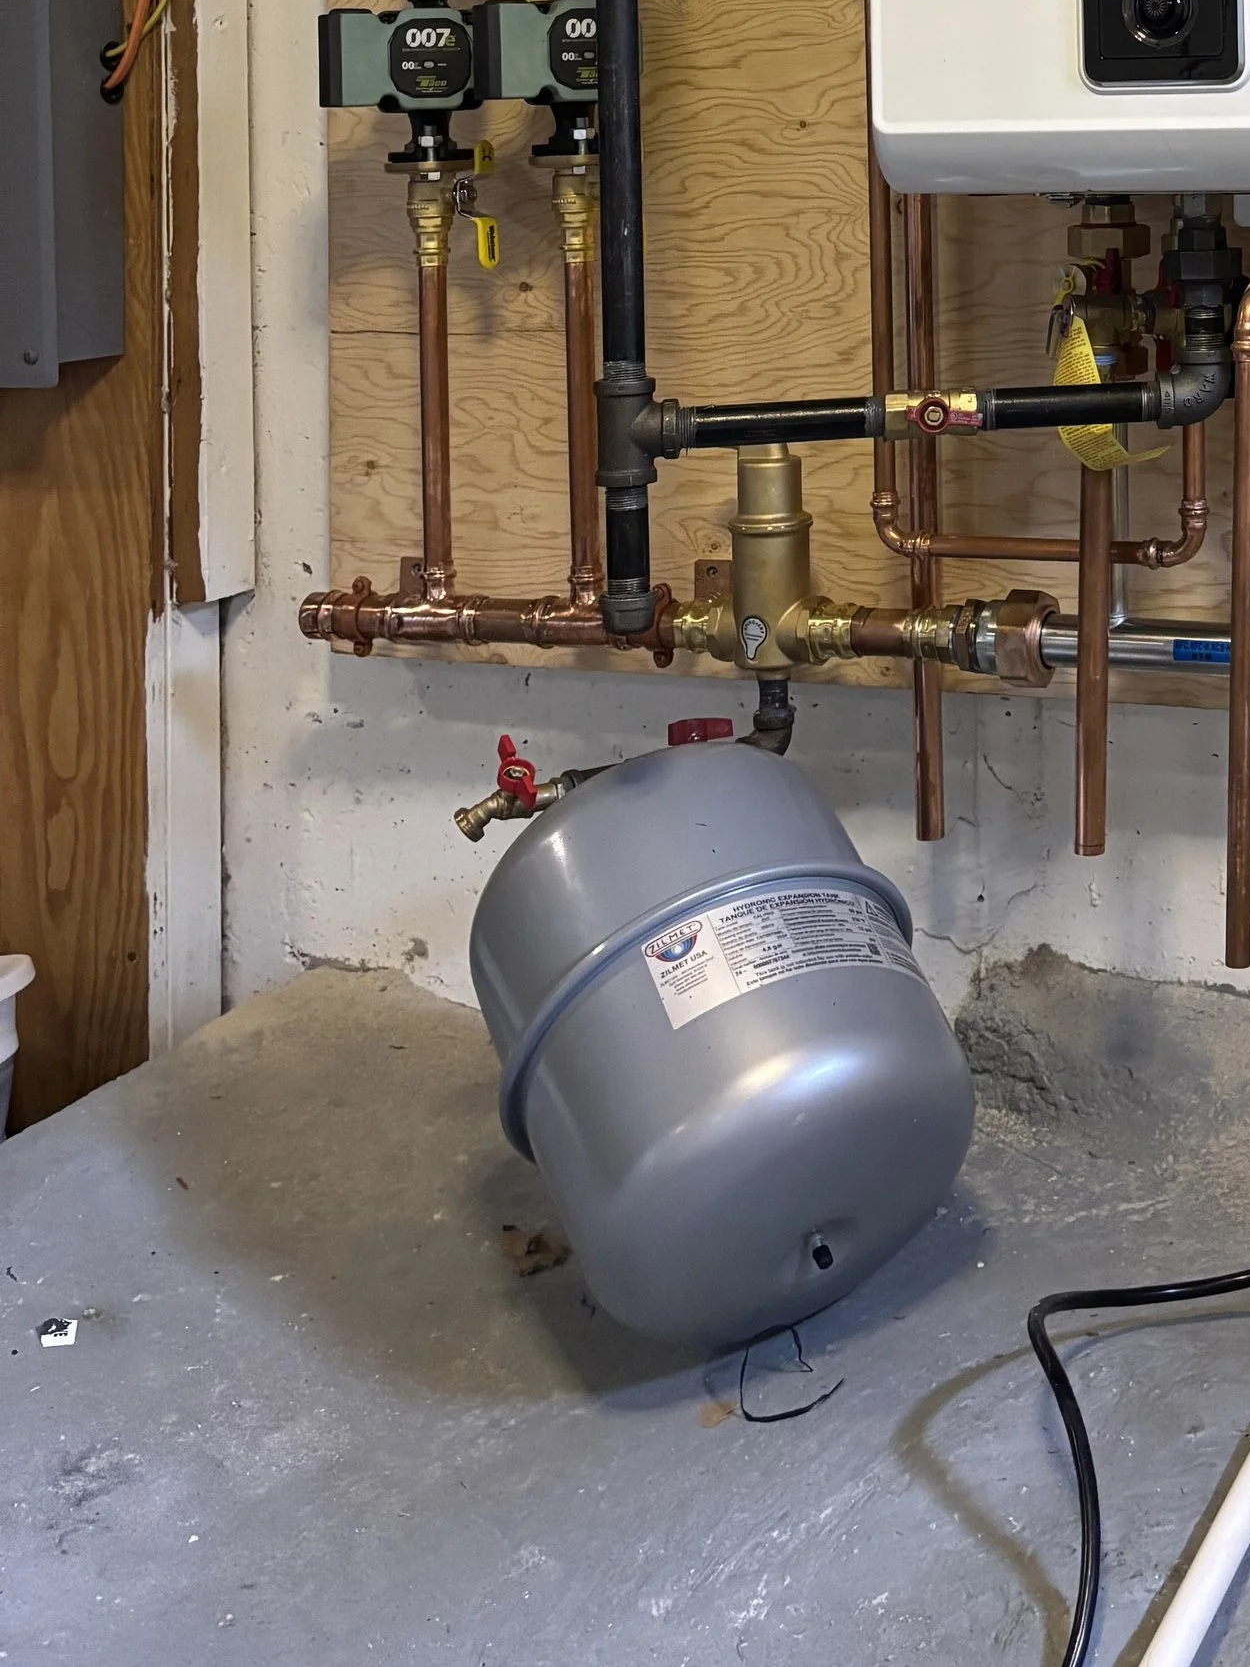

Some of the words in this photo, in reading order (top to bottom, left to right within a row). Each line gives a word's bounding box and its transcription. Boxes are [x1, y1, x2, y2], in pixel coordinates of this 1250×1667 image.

[732, 896, 776, 913] HYDRONIC
[777, 892, 821, 903] EXPANSION
[719, 908, 755, 924] TANQUE
[648, 922, 696, 955] ZILMET
[660, 956, 691, 979] ZILMET
[690, 949, 708, 962] USA
